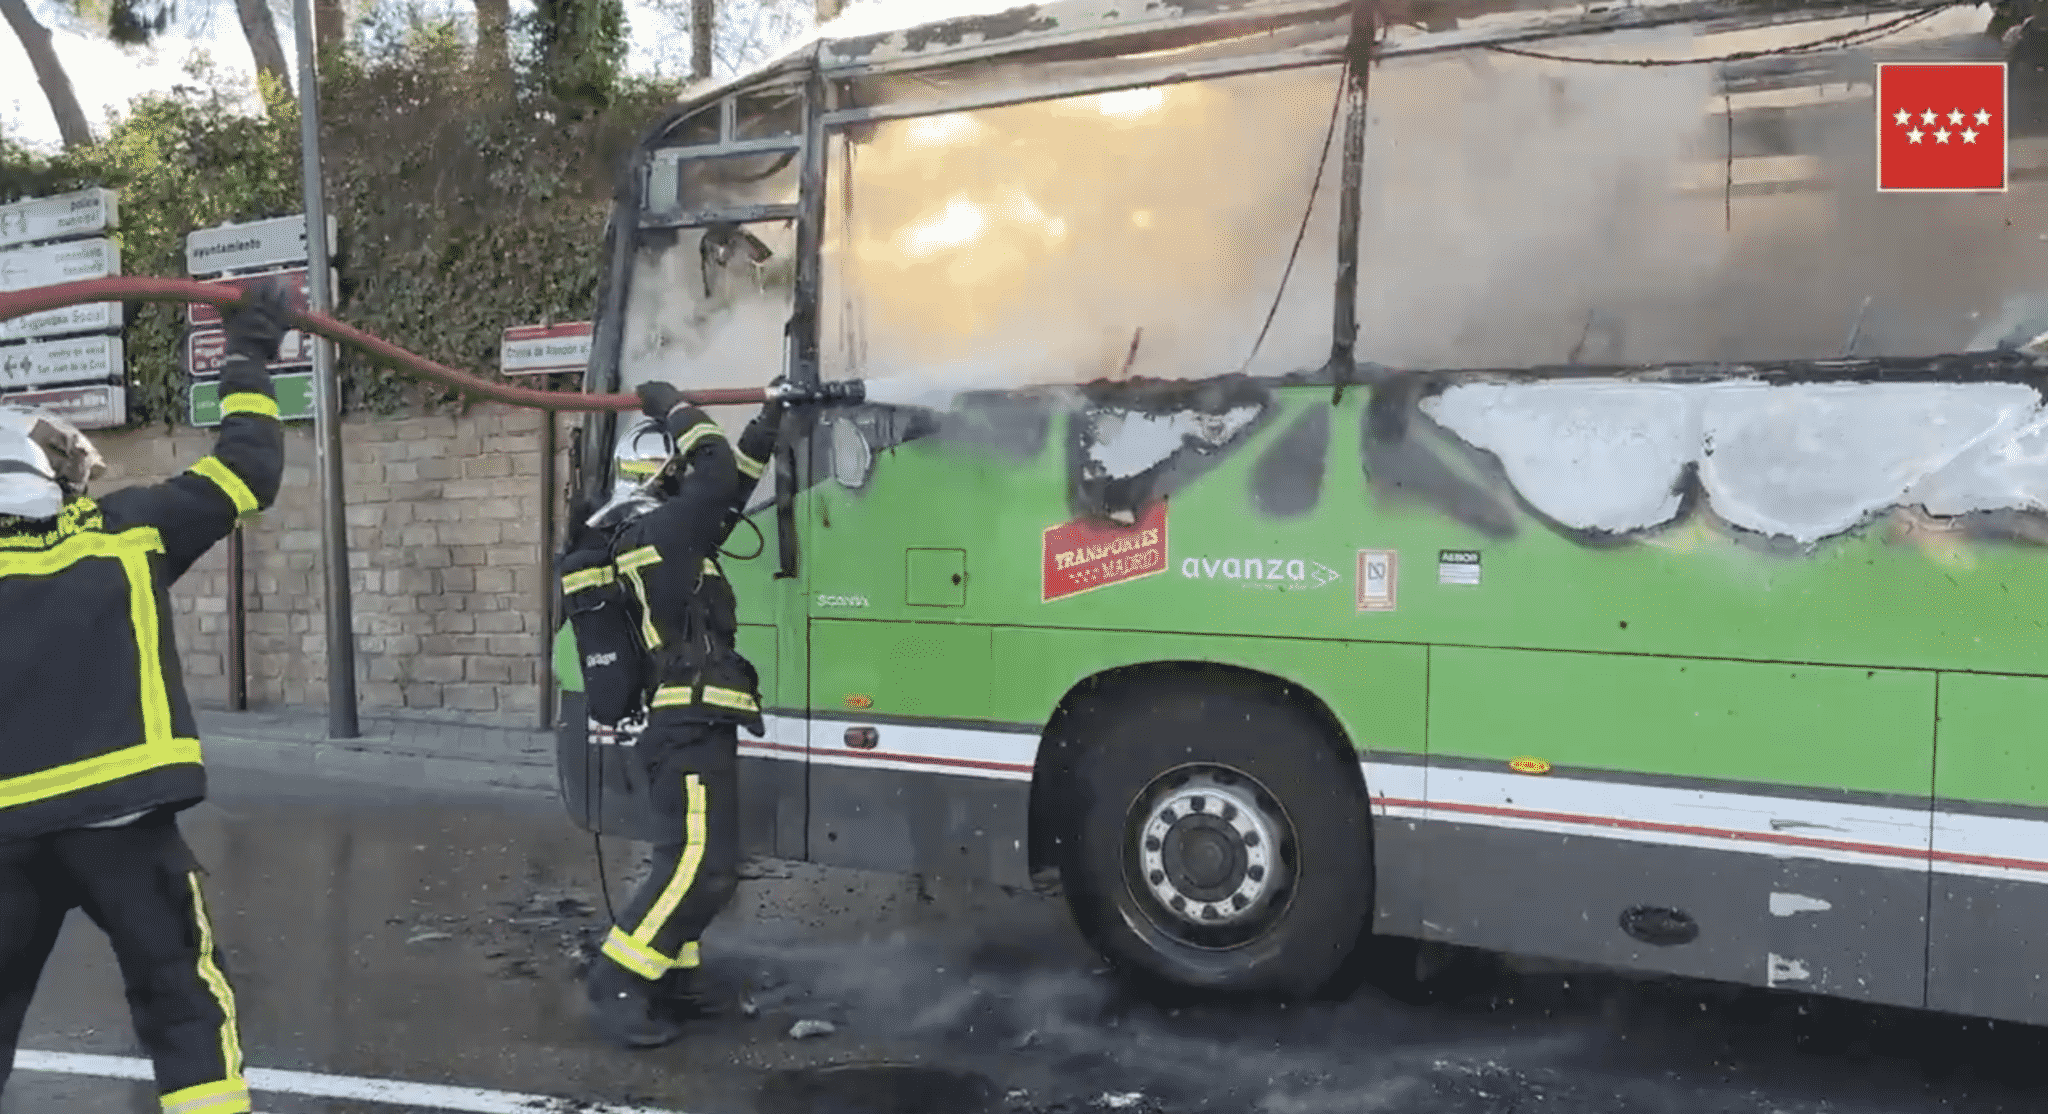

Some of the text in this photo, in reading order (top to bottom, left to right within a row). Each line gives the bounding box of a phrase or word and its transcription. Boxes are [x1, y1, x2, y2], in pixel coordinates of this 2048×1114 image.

[193, 238, 261, 259] ayuntamiento
[1054, 528, 1159, 571] TRANSPORTES
[1101, 549, 1159, 579] MADRID
[1181, 557, 1305, 580] avanza
[816, 594, 870, 608] SCANIA
